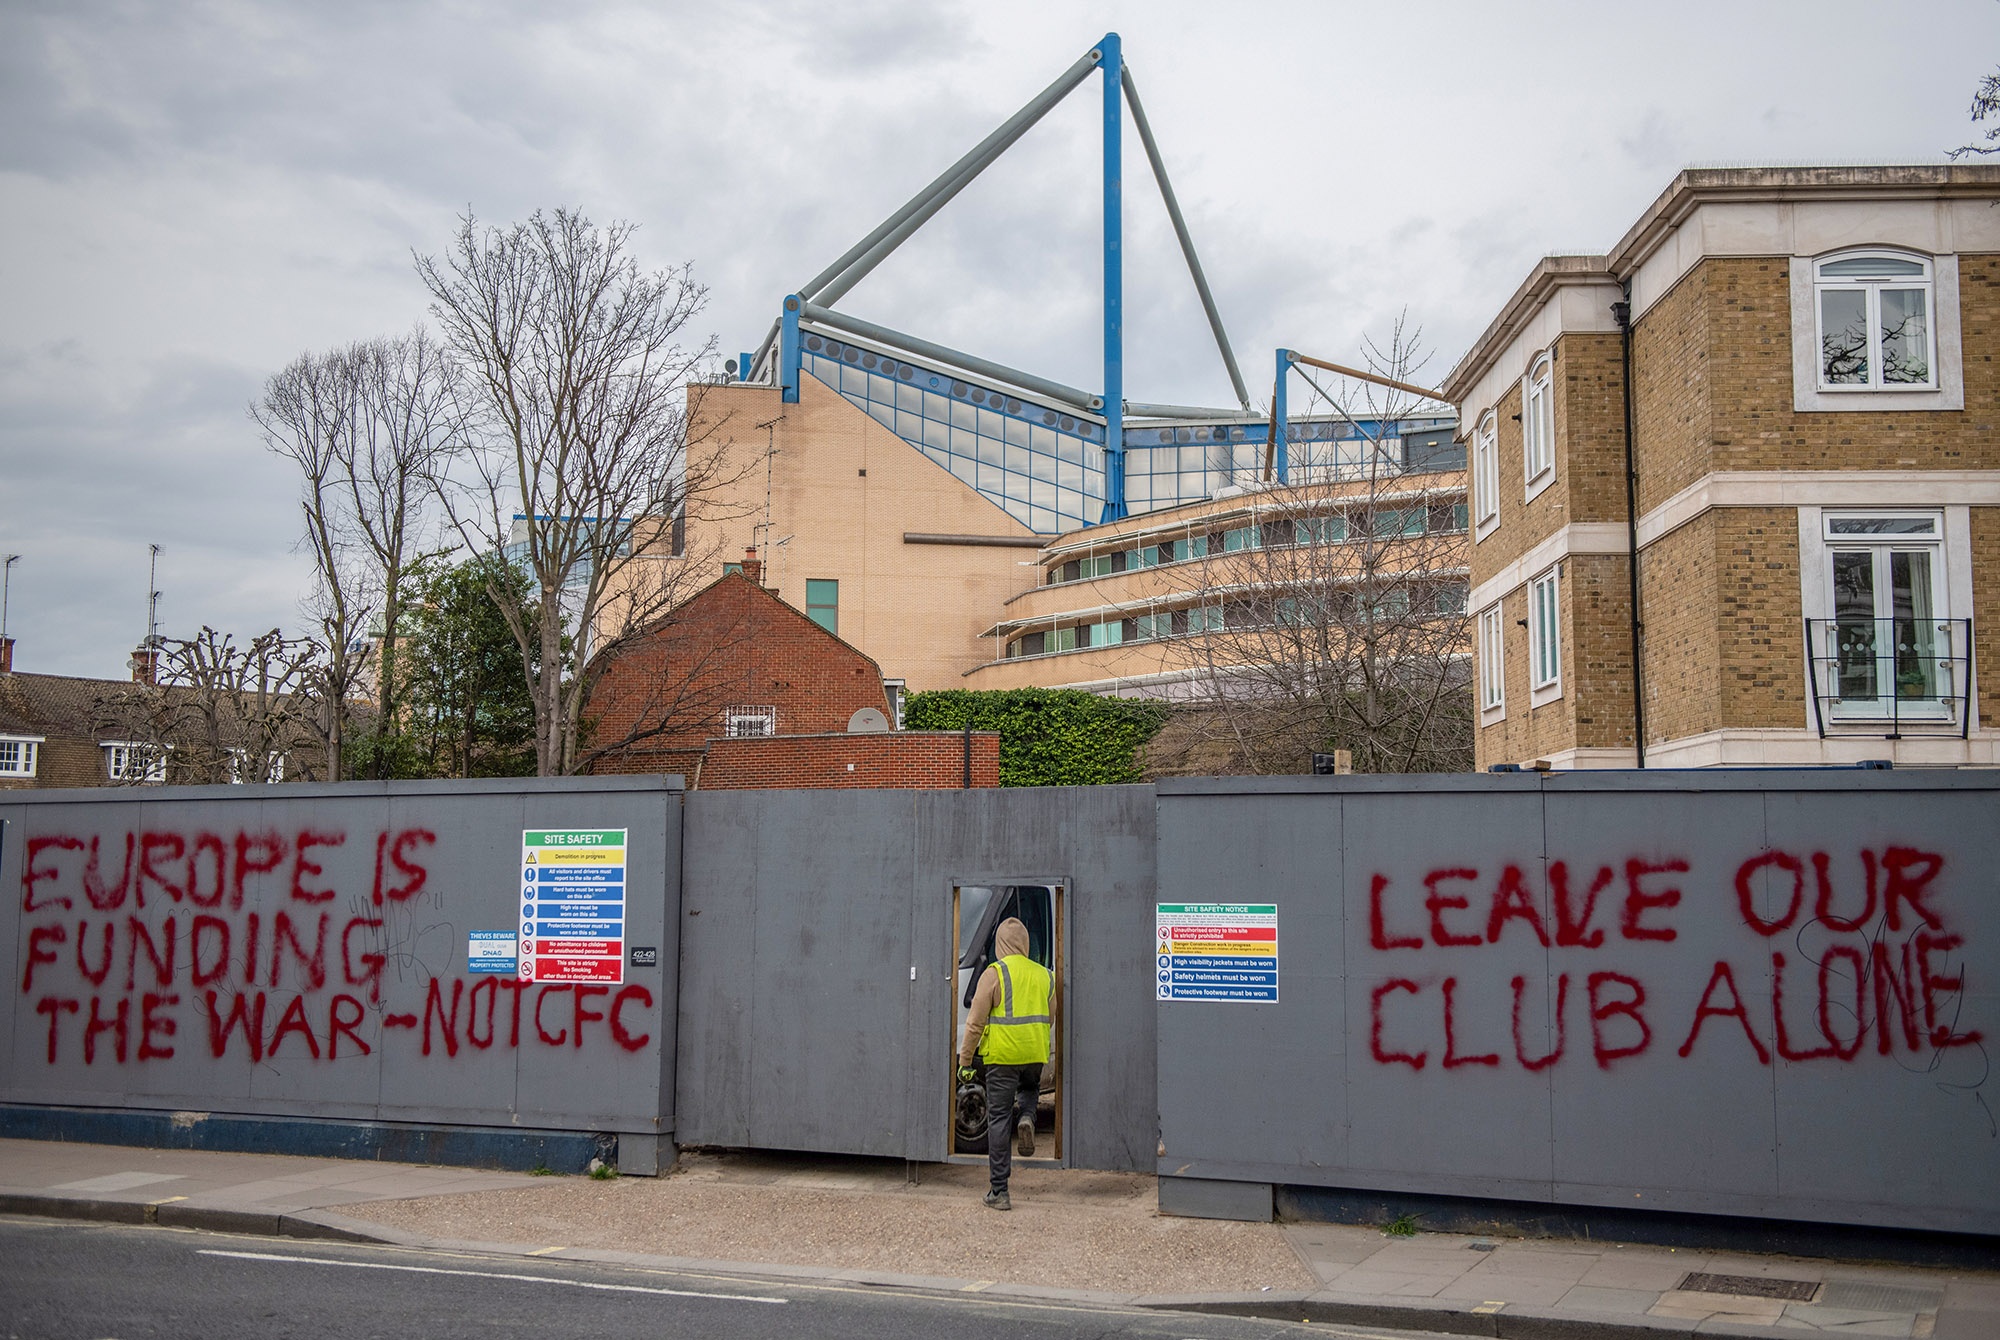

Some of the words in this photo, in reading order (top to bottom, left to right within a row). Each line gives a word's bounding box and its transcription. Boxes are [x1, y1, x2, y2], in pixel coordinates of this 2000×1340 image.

[22, 829, 347, 911] EUROPE
[374, 828, 438, 905] IS
[544, 835, 565, 844] SITE
[567, 834, 603, 843] SAFETY
[1371, 861, 1689, 949] LEAVE
[1735, 847, 1943, 936] OUR
[23, 910, 386, 1000] FUNDING
[1174, 973, 1194, 981] Safety
[37, 994, 180, 1064] THE
[1372, 971, 1651, 1070] CLUB
[1678, 933, 1984, 1065] ALONE
